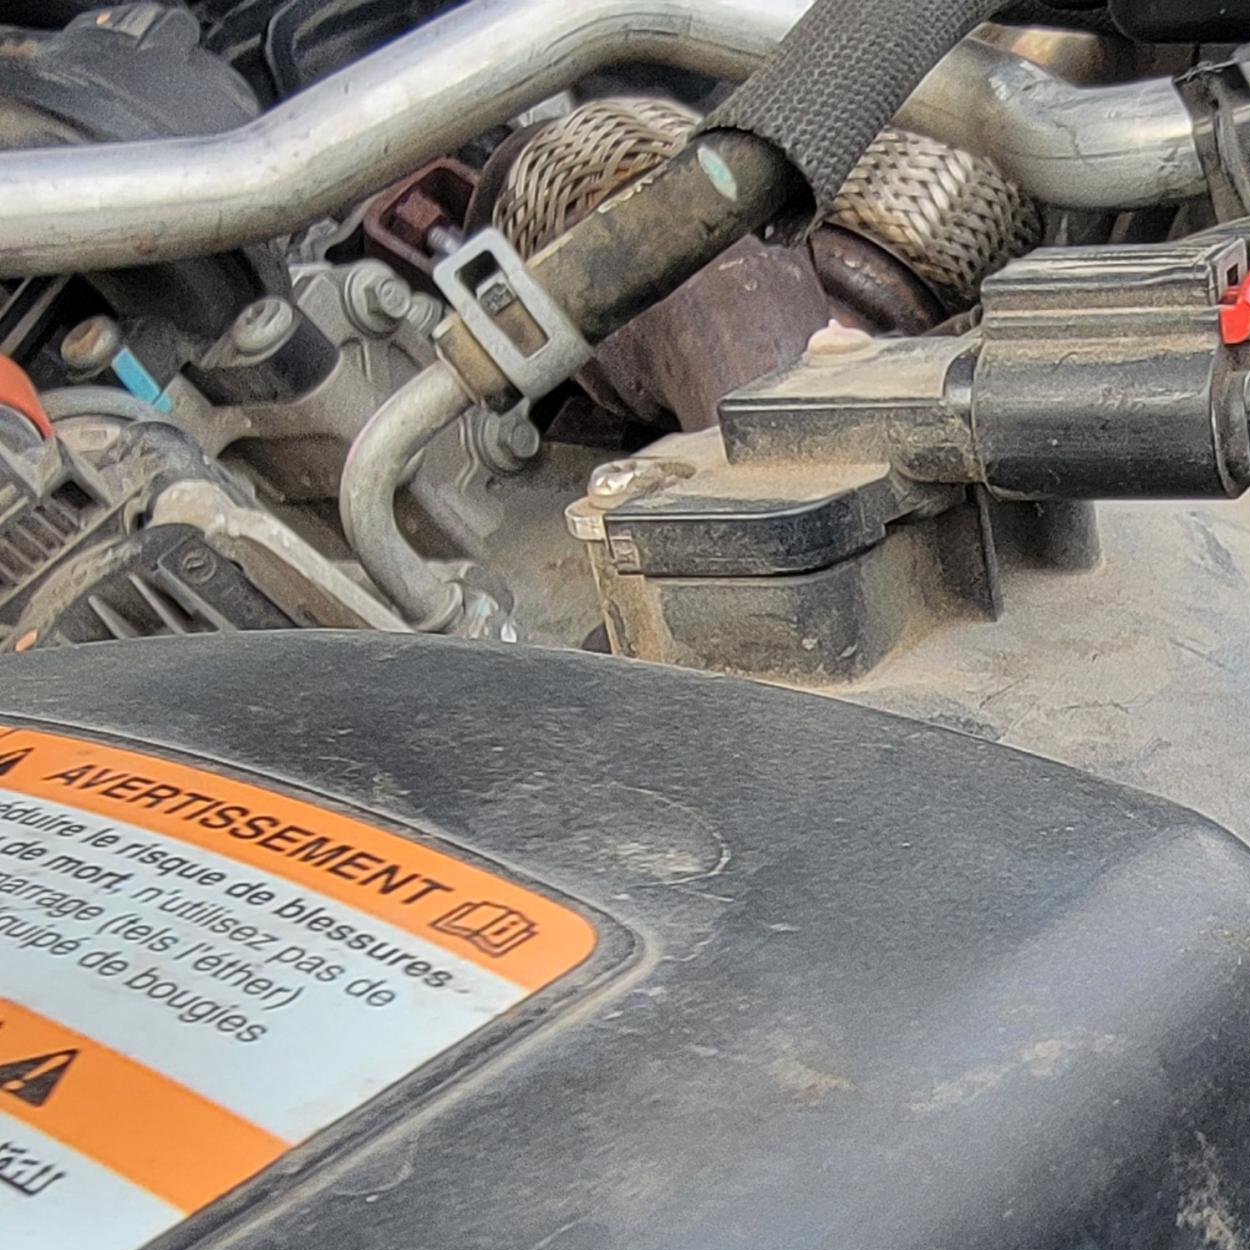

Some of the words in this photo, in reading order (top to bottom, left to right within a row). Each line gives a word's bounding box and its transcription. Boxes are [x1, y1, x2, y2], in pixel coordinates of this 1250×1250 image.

[42, 764, 454, 905] AVERTISSEMENT
[0, 905, 92, 955] quipé
[77, 951, 130, 976] de
[124, 967, 268, 1042] bougies
[2, 841, 48, 862] de
[41, 855, 134, 894] mort,
[130, 887, 279, 950] n'utilisez
[264, 946, 346, 983] pas
[343, 978, 397, 1007] de
[79, 828, 122, 848] le
[115, 843, 227, 885] risque
[225, 882, 276, 906] de
[272, 898, 454, 989] blessures
[95, 914, 179, 951] (tels
[173, 943, 305, 1011] l'éther)
